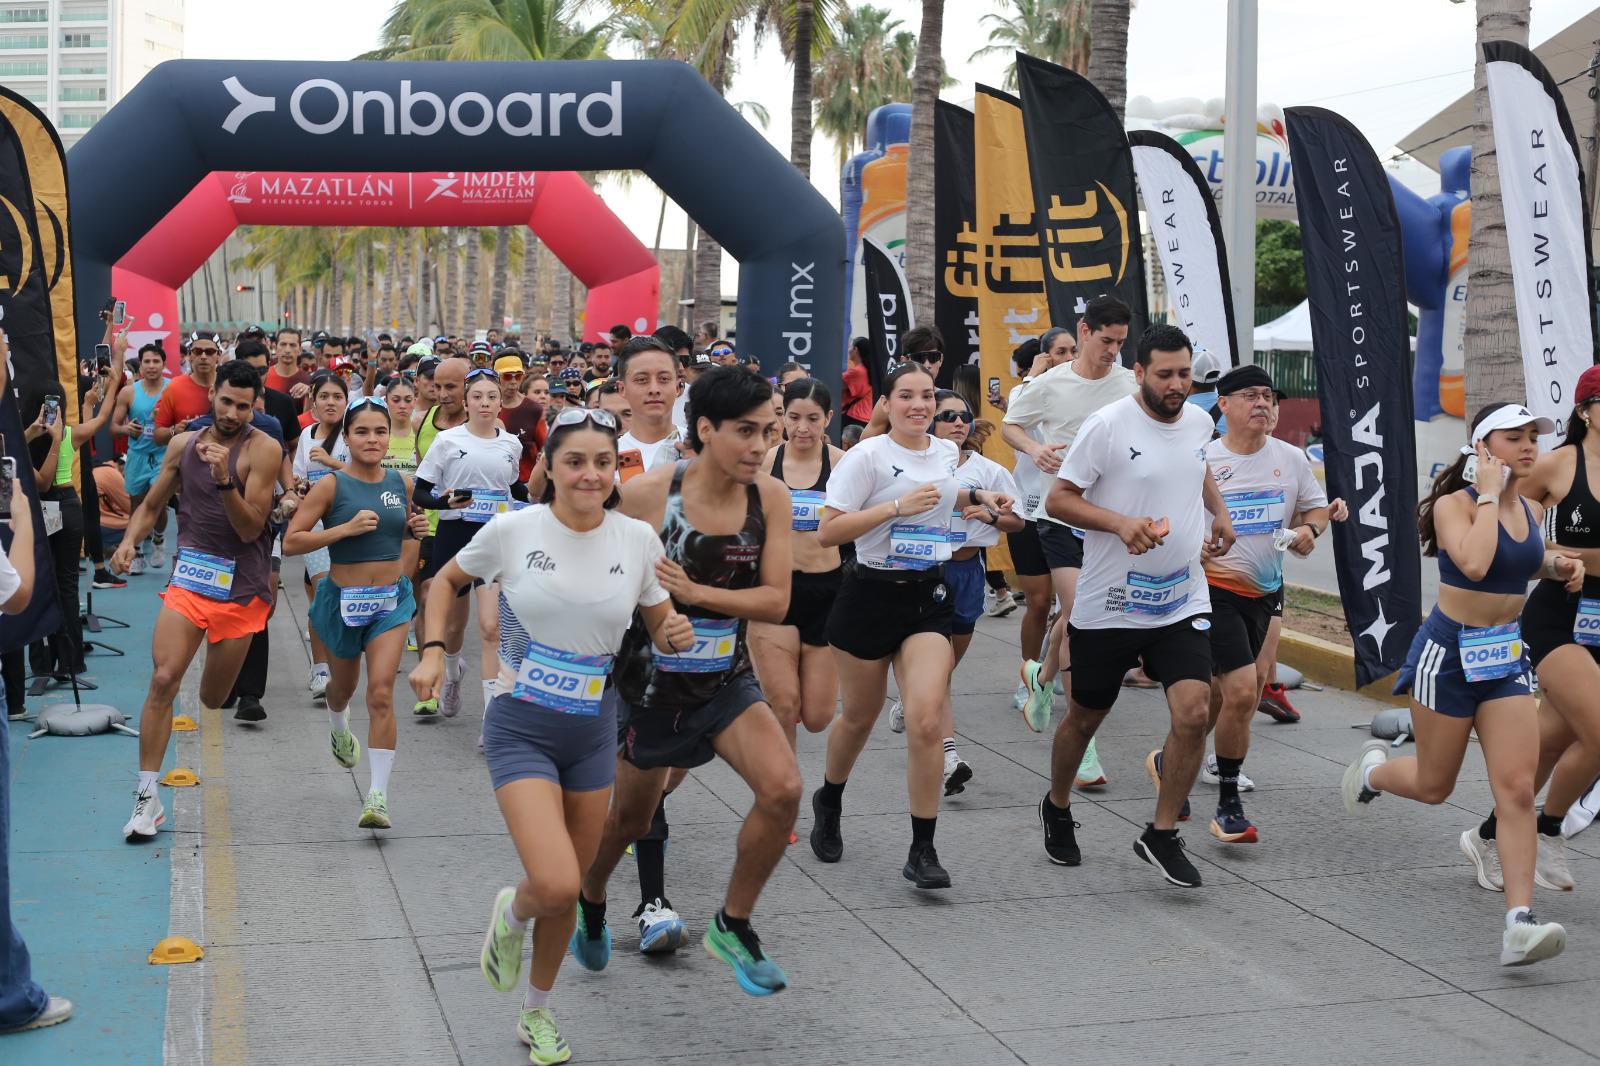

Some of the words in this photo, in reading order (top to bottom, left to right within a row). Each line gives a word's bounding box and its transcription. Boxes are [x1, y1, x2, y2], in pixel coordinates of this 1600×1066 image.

[289, 78, 623, 137] Onboard
[261, 174, 393, 197] MAZATLÁN
[463, 172, 536, 187] IMDEM
[1045, 190, 1112, 283] fit
[985, 213, 1045, 294] fit
[1334, 158, 1369, 389] SPORTSWEAR
[381, 491, 402, 507] Pata
[1230, 508, 1265, 522] 0367
[895, 542, 934, 556] 0296
[526, 550, 556, 571] Pata
[178, 564, 214, 581] 0068
[1130, 589, 1171, 602] 0297
[346, 602, 380, 613] 0190
[1577, 618, 1600, 630] 00
[1464, 646, 1509, 664] 0045
[528, 668, 580, 692] 0013
